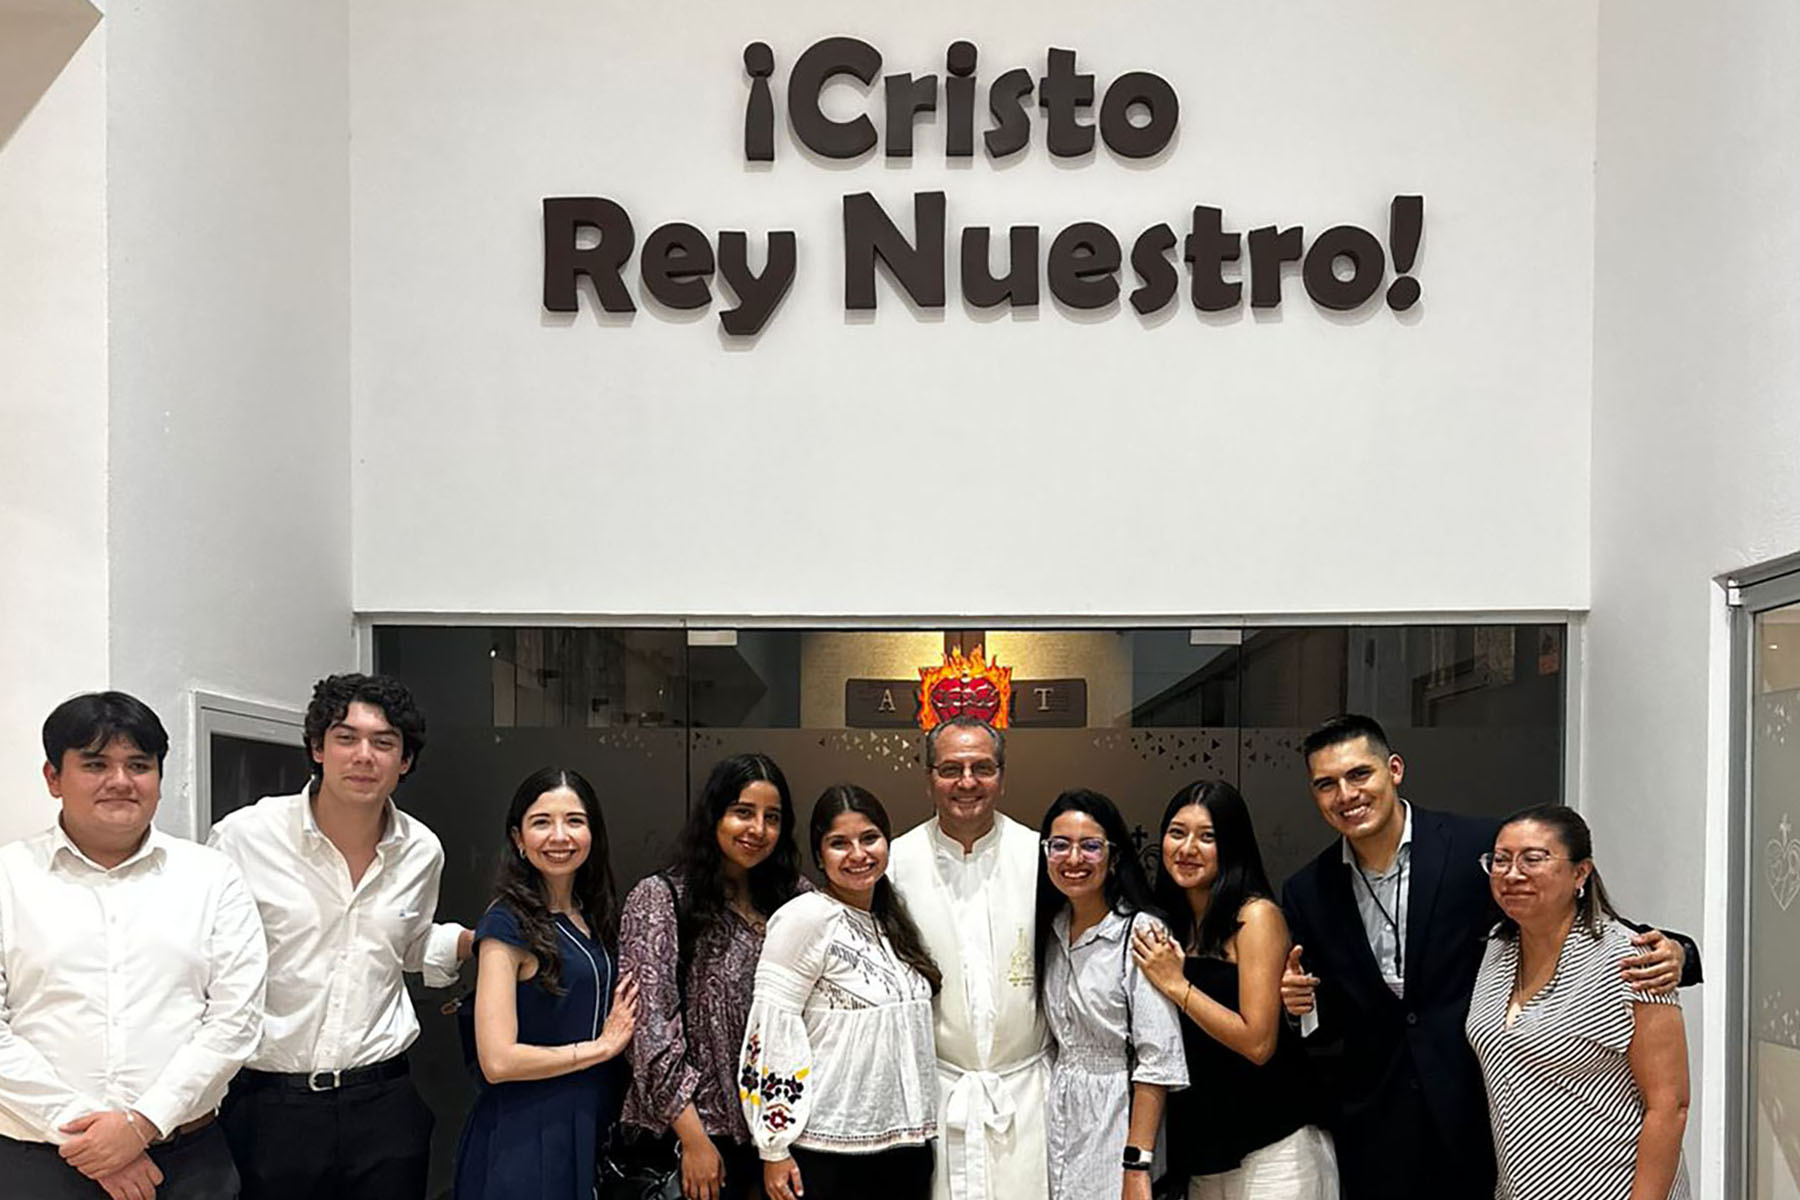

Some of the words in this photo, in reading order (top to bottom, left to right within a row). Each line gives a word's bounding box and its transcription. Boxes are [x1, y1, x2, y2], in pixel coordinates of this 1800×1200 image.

[743, 36, 1180, 162] ¡Cristo
[542, 197, 797, 336] Rey
[843, 190, 1424, 316] Nuestro!
[878, 688, 896, 711] A
[1033, 688, 1054, 711] T
